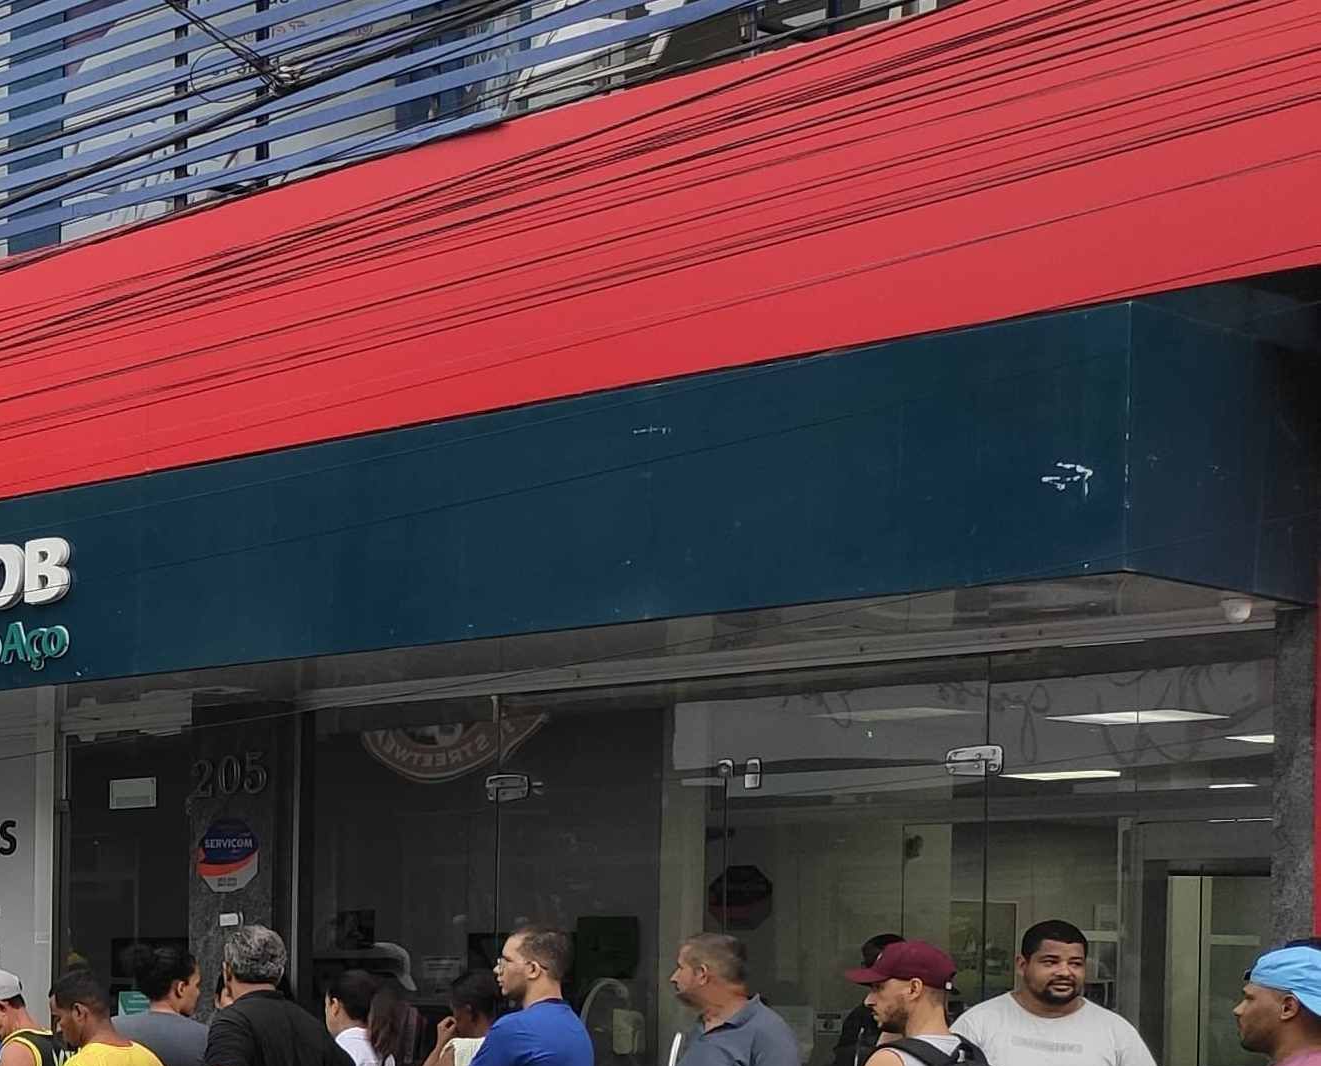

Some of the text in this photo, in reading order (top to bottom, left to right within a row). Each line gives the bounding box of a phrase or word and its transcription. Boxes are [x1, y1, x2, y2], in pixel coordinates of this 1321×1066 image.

[1, 622, 70, 671] Aço
[192, 752, 268, 799] 205
[204, 838, 253, 849] SERVICOM
